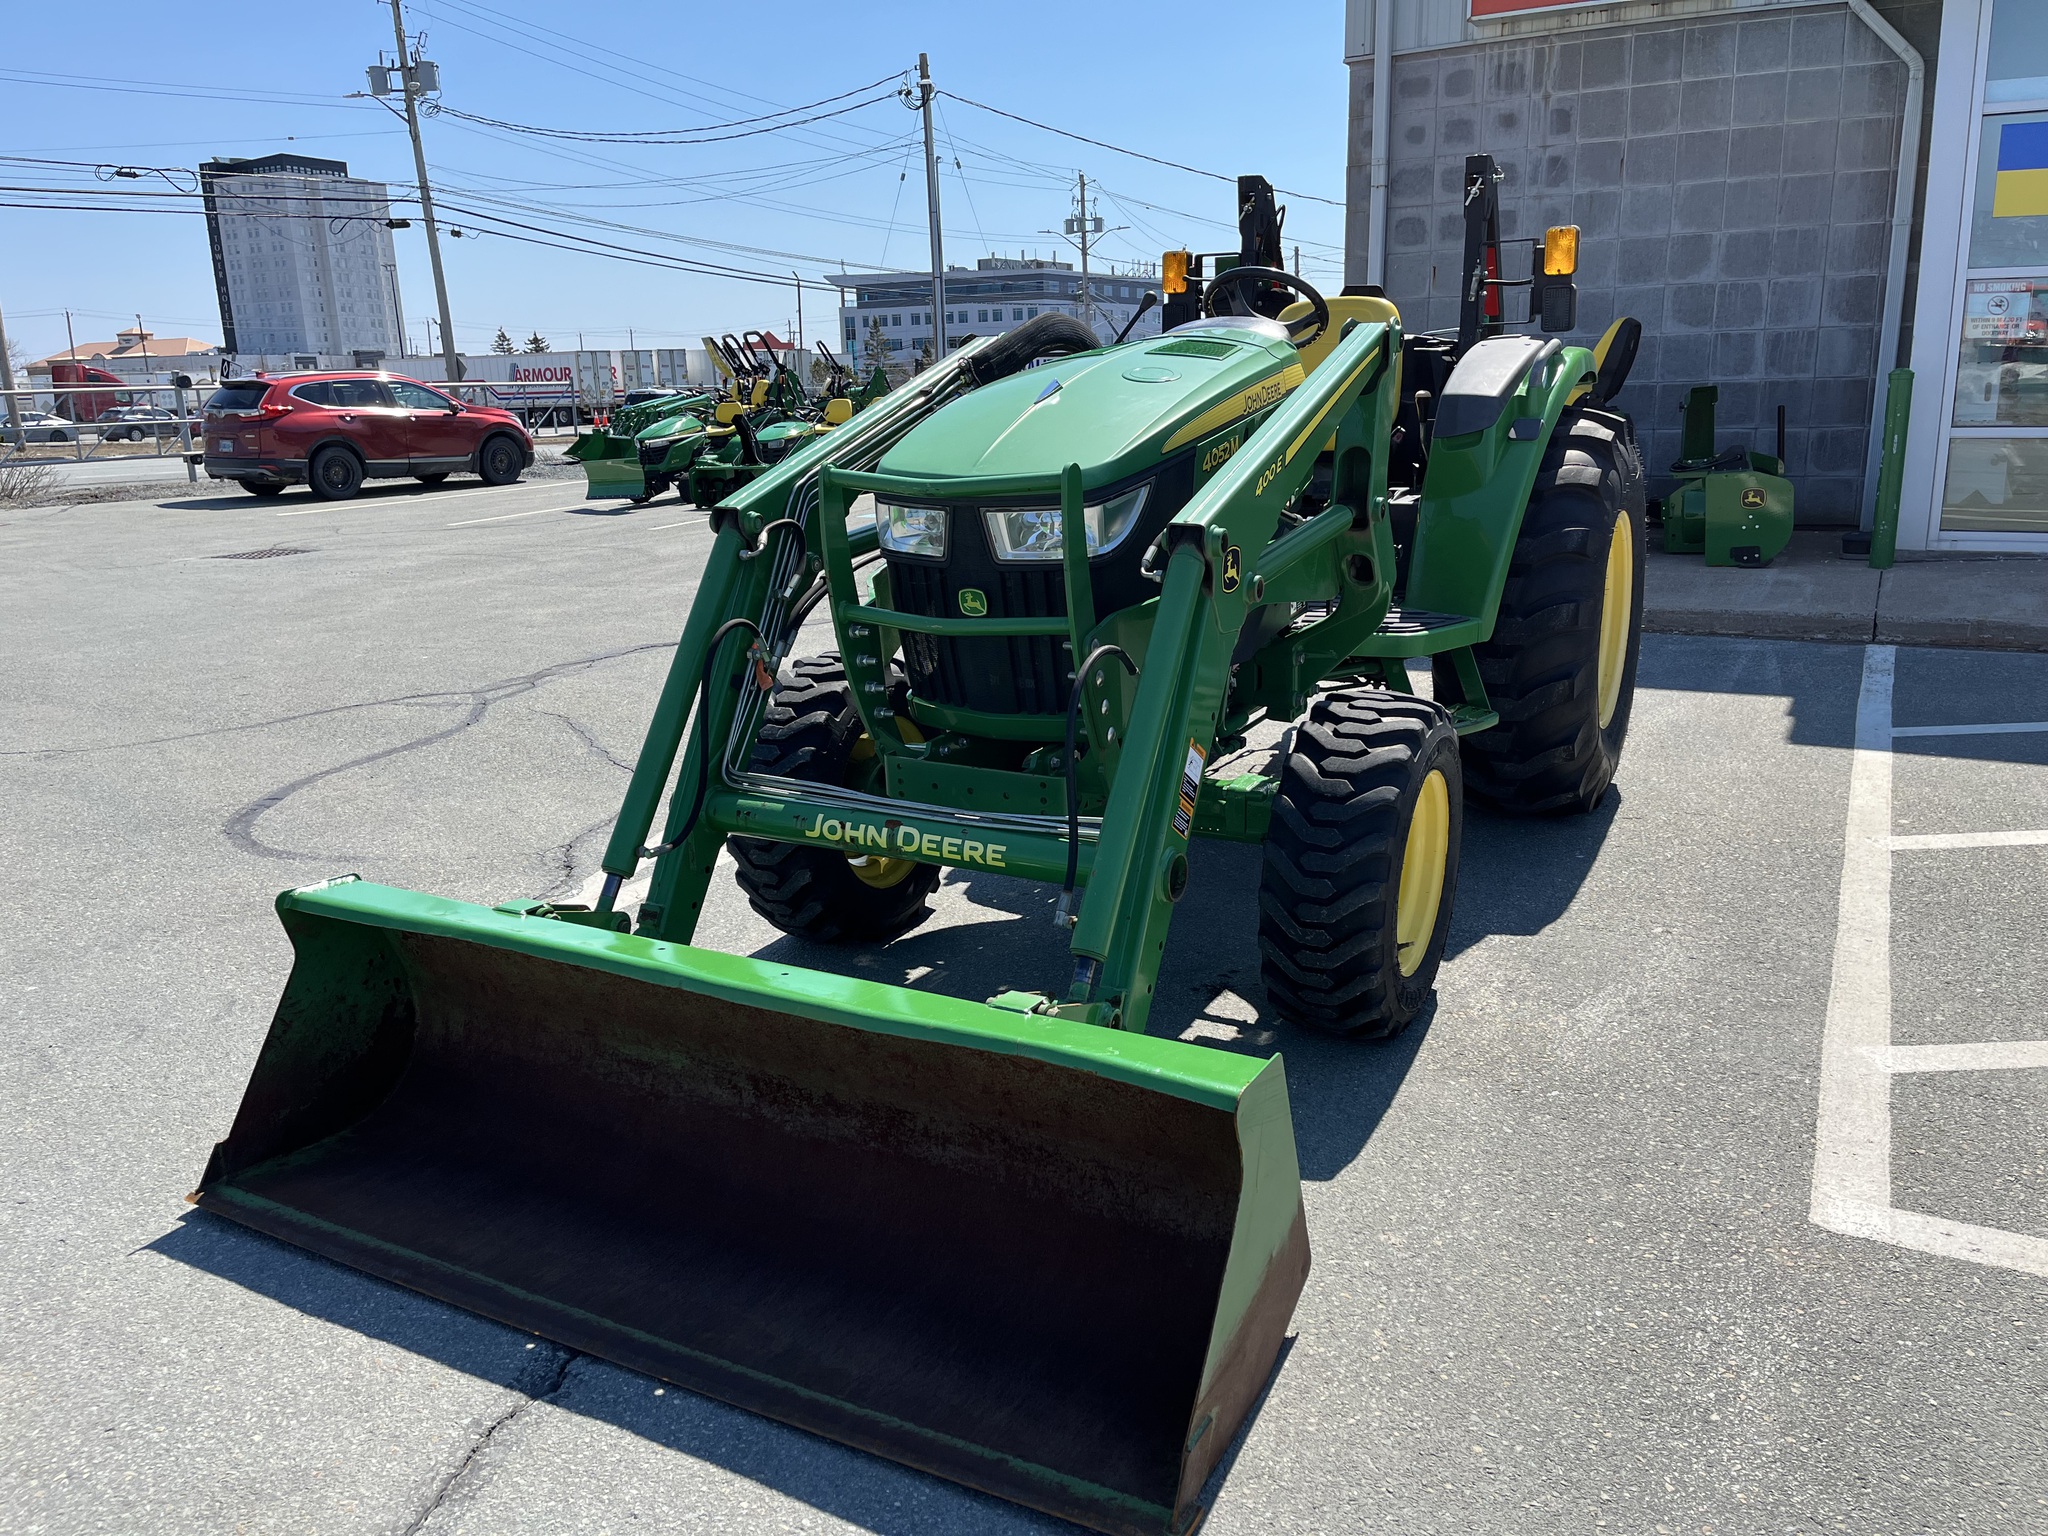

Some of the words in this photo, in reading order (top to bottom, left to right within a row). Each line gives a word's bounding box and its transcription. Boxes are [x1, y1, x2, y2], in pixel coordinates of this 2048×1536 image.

[214, 235, 224, 279] TOWER
[220, 286, 231, 329] HOTEL
[1974, 283, 1986, 292] NO
[1987, 282, 2026, 292] SMOKING
[514, 366, 572, 382] ARMOUR
[1261, 382, 1282, 404] DEERE
[1203, 435, 1239, 471] 4052M
[804, 813, 888, 849] JOHN
[897, 825, 1007, 868] DEERE
